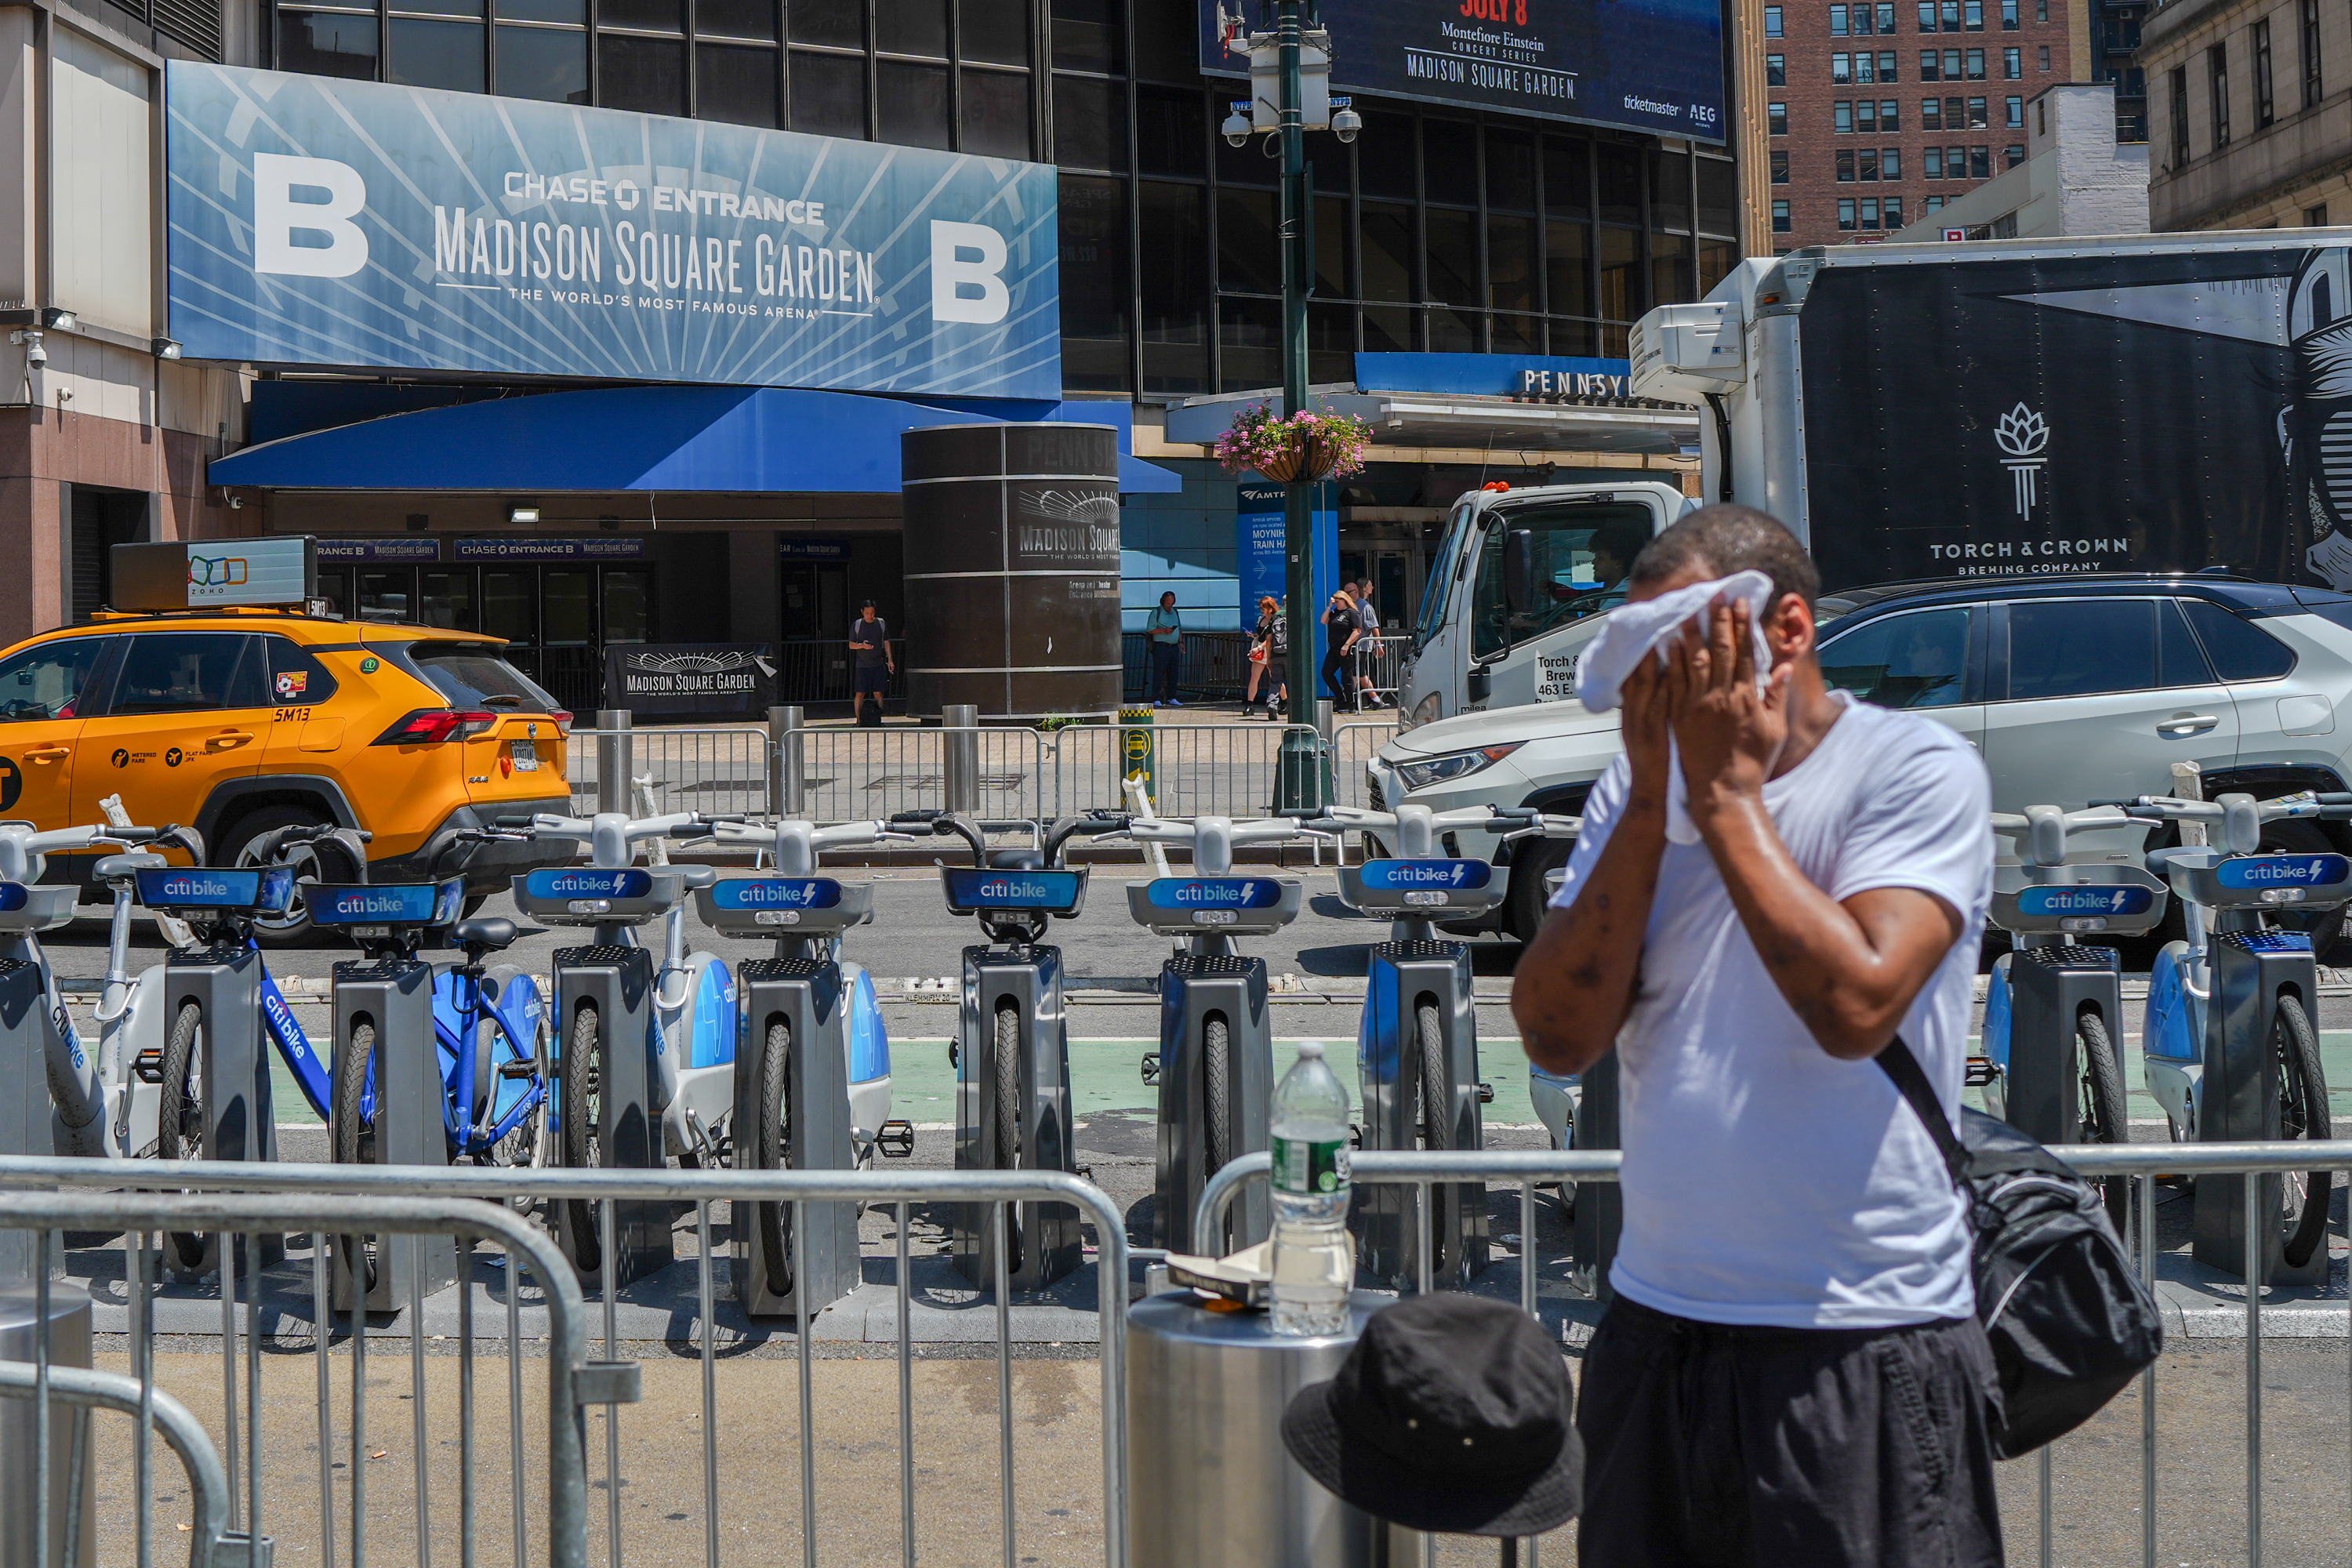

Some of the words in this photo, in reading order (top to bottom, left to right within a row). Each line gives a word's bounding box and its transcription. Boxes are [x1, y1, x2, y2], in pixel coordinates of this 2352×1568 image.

[1460, 0, 1508, 22] JULY
[1515, 0, 1528, 26] 8
[1441, 21, 1501, 45] Montefiore
[1503, 31, 1544, 52] Einstein
[1452, 41, 1497, 56] CONCERT
[1502, 49, 1537, 63] SERIES
[1407, 53, 1465, 83] MADISON
[1472, 63, 1519, 93] SQUARE
[1524, 71, 1574, 100] GARDEN
[1232, 101, 1252, 110] NYPD
[1624, 94, 1679, 116] ticketmaster
[1690, 103, 1715, 122] AEG
[503, 171, 608, 205] CHASE
[653, 186, 825, 226] ENTRANCE
[254, 151, 369, 279] B
[434, 204, 601, 283] MADISON
[615, 220, 743, 293] SQUARE
[755, 233, 873, 304] GARDEN
[931, 219, 1010, 325] B
[508, 287, 543, 301] THE
[551, 289, 630, 307] WORLD'S
[638, 296, 685, 310] MOST
[691, 299, 758, 316] FAMOUS
[764, 306, 815, 320] ARENA
[1020, 524, 1085, 550] MADISON
[1252, 528, 1286, 539] MOYNIH
[355, 546, 365, 556] B
[462, 546, 496, 554] CHASE
[565, 545, 574, 554] B
[1253, 540, 1275, 549] TRAIN
[1930, 543, 2013, 559] TORCH
[2020, 541, 2034, 556] &
[2040, 538, 2128, 556] CROWN
[1958, 564, 2024, 575] BREWING
[2031, 561, 2101, 574] COMPANY
[1096, 580, 1111, 589] heater
[310, 600, 325, 617] 5M13
[1537, 655, 1569, 668] Torch
[626, 674, 672, 691] MADISON
[676, 673, 713, 692] SQUARE
[717, 673, 754, 689] GARDEN
[1546, 670, 1576, 681] Brew
[1538, 684, 1559, 695] 463
[1563, 684, 1573, 695] E.
[274, 708, 310, 721] 5M13
[1461, 705, 1486, 714] milea
[941, 993, 951, 1002] 20
[280, 1018, 305, 1059] bike
